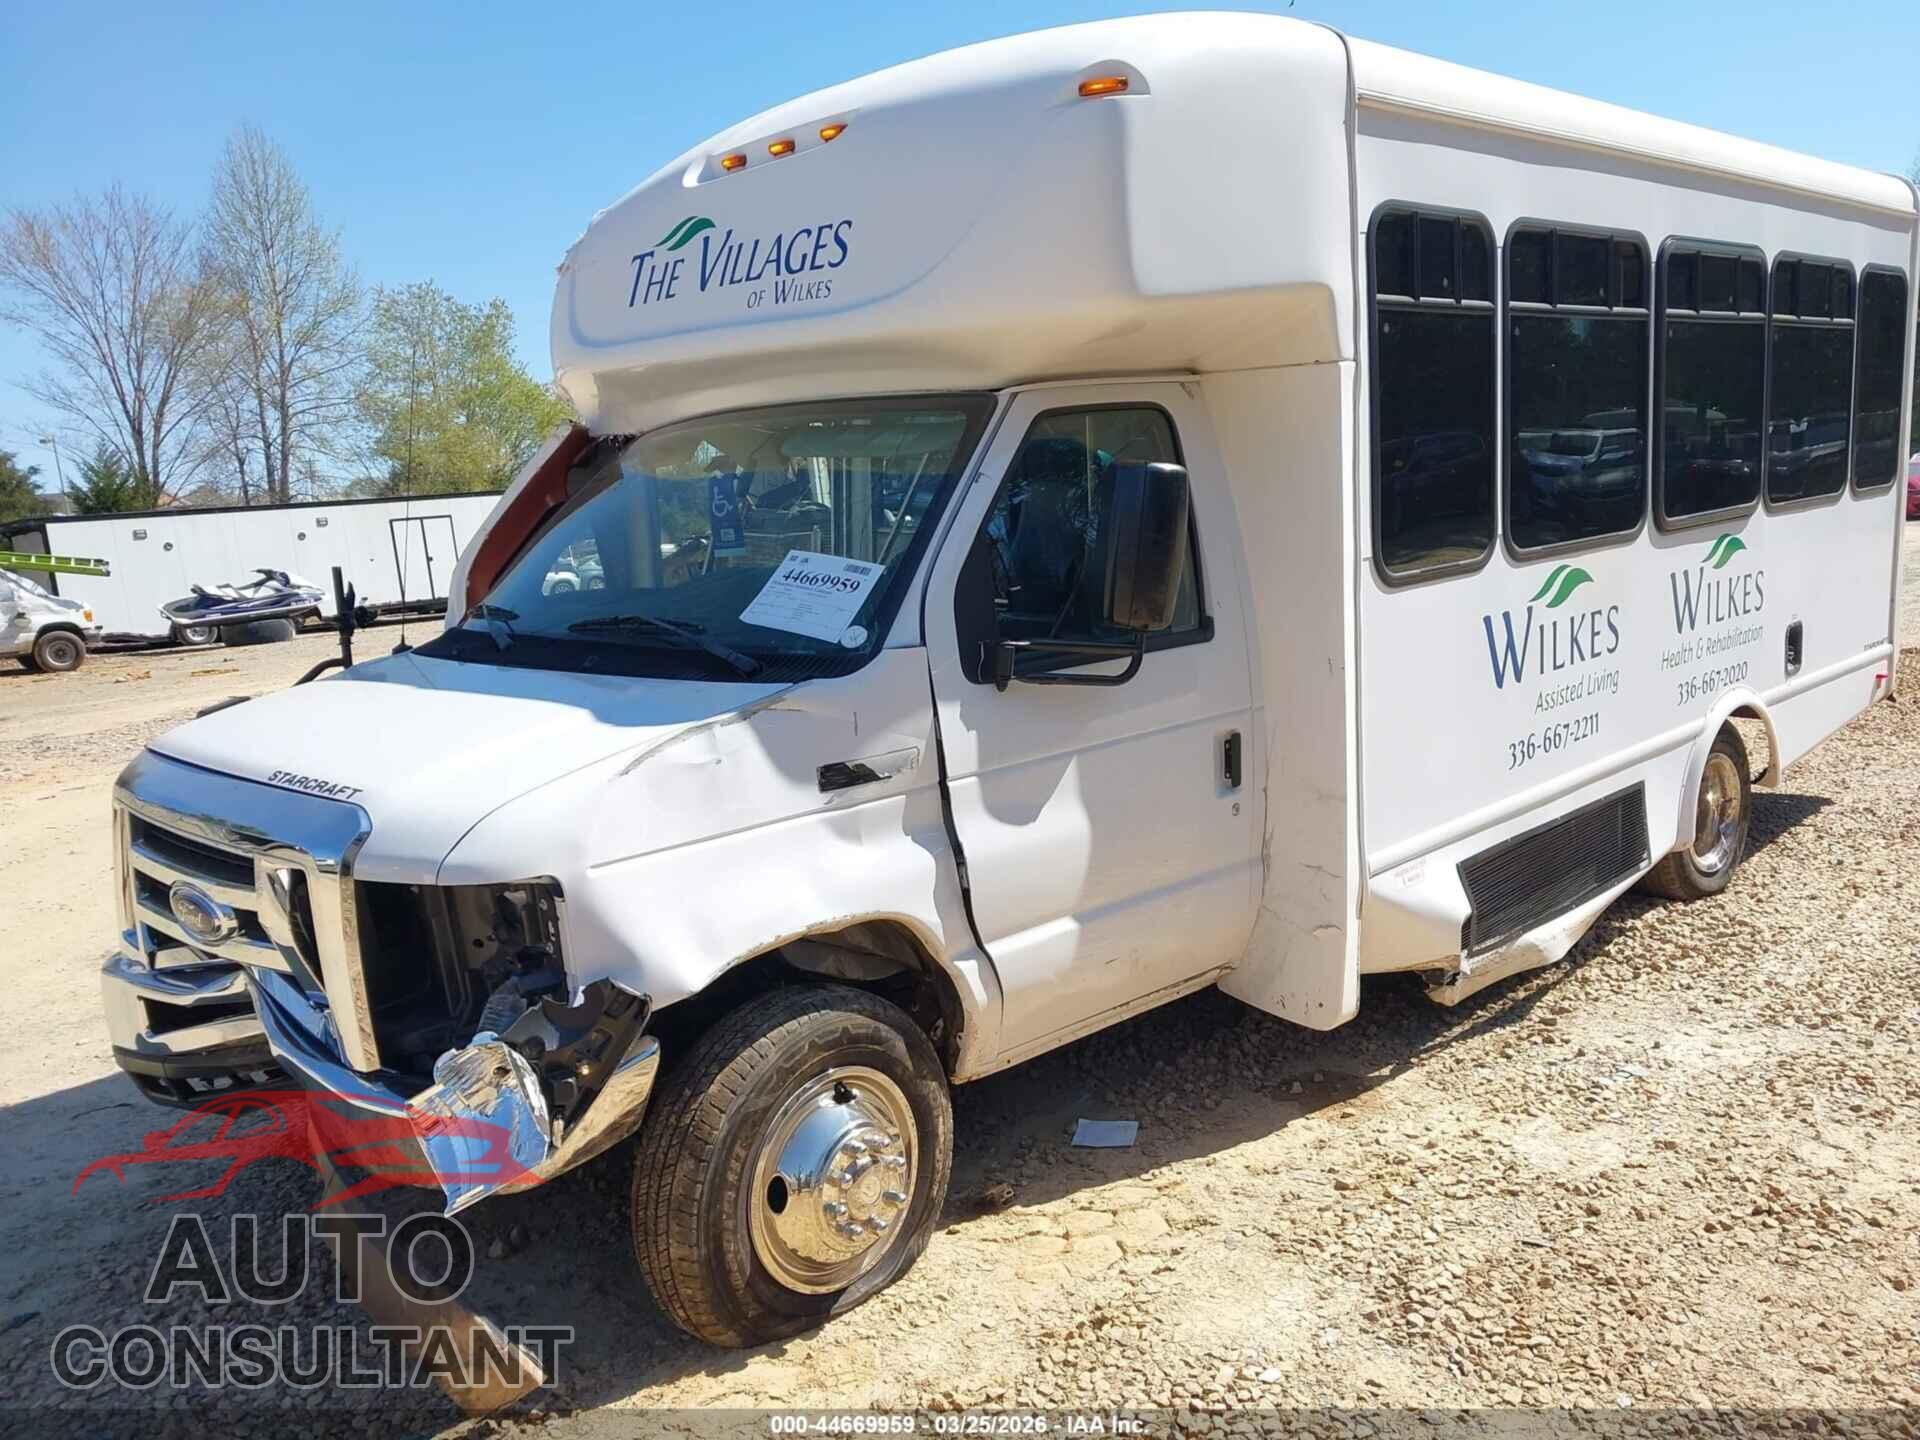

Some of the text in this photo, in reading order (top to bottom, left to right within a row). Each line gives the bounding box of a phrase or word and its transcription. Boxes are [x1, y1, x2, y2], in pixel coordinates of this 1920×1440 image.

[628, 219, 853, 308] THE VILLAGES
[746, 279, 833, 309] OF WILKES
[782, 567, 861, 594] 44669959
[1669, 566, 1766, 635] WILKES
[1482, 604, 1621, 690] WILKES
[1661, 639, 1694, 672] Health
[1705, 624, 1764, 657] Rehabilitation
[1534, 667, 1621, 715] Assisted Living
[1677, 660, 1749, 707] 336-667-2020
[1508, 711, 1600, 771] 336-667-2211
[267, 769, 365, 800] STARCRAFT
